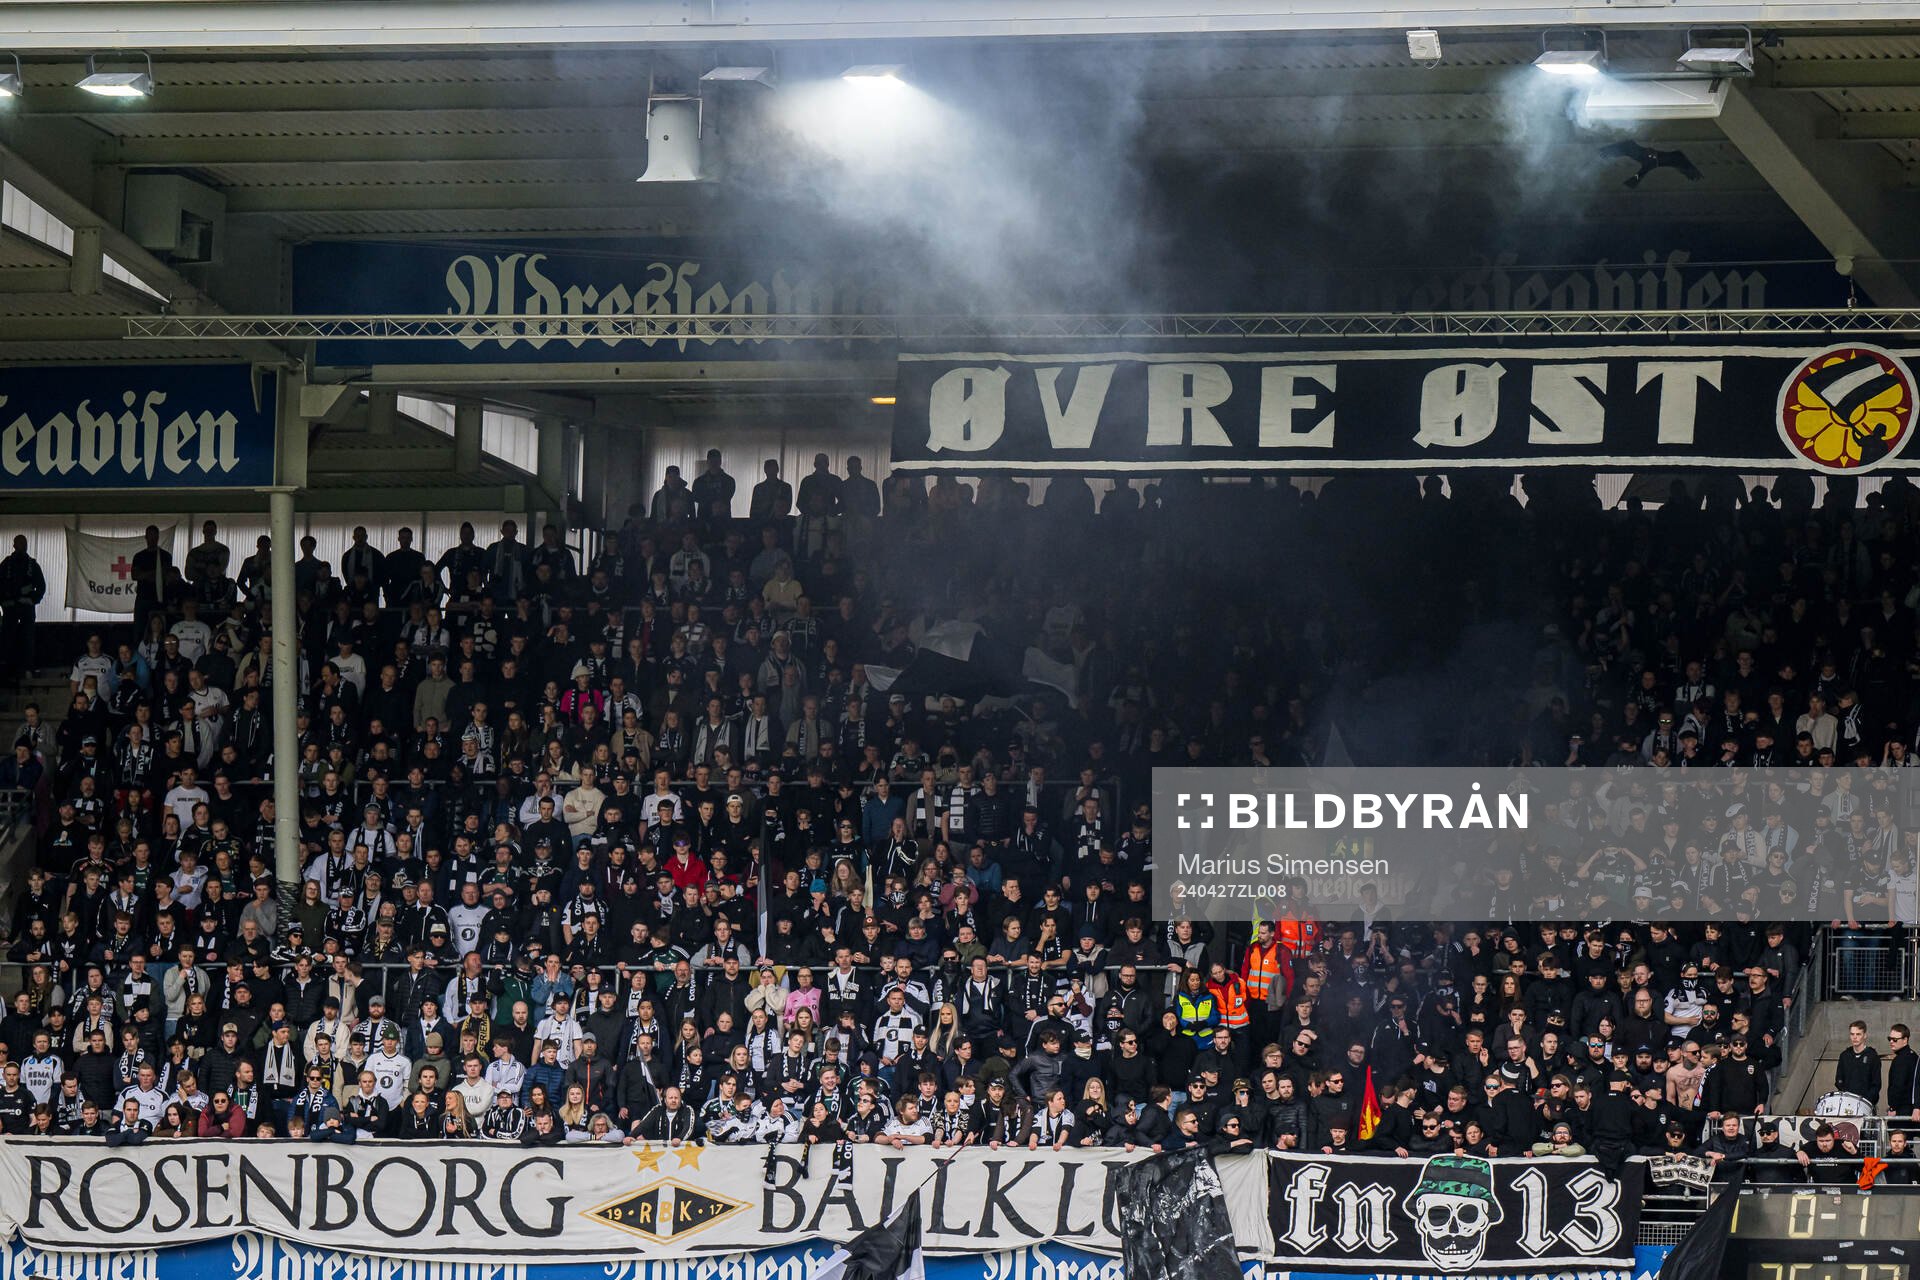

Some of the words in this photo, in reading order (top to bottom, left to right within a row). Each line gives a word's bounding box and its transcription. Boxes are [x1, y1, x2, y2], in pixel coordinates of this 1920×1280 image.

[926, 362, 1337, 452] ØVRE
[1413, 360, 1722, 448] ØST
[89, 580, 121, 595] Røde
[125, 583, 137, 594] K
[22, 1153, 575, 1238] ROSENBORG
[606, 1208, 622, 1221] 19
[639, 1198, 692, 1224] RBK
[709, 1203, 723, 1216] 17
[1509, 1167, 1622, 1257] 13
